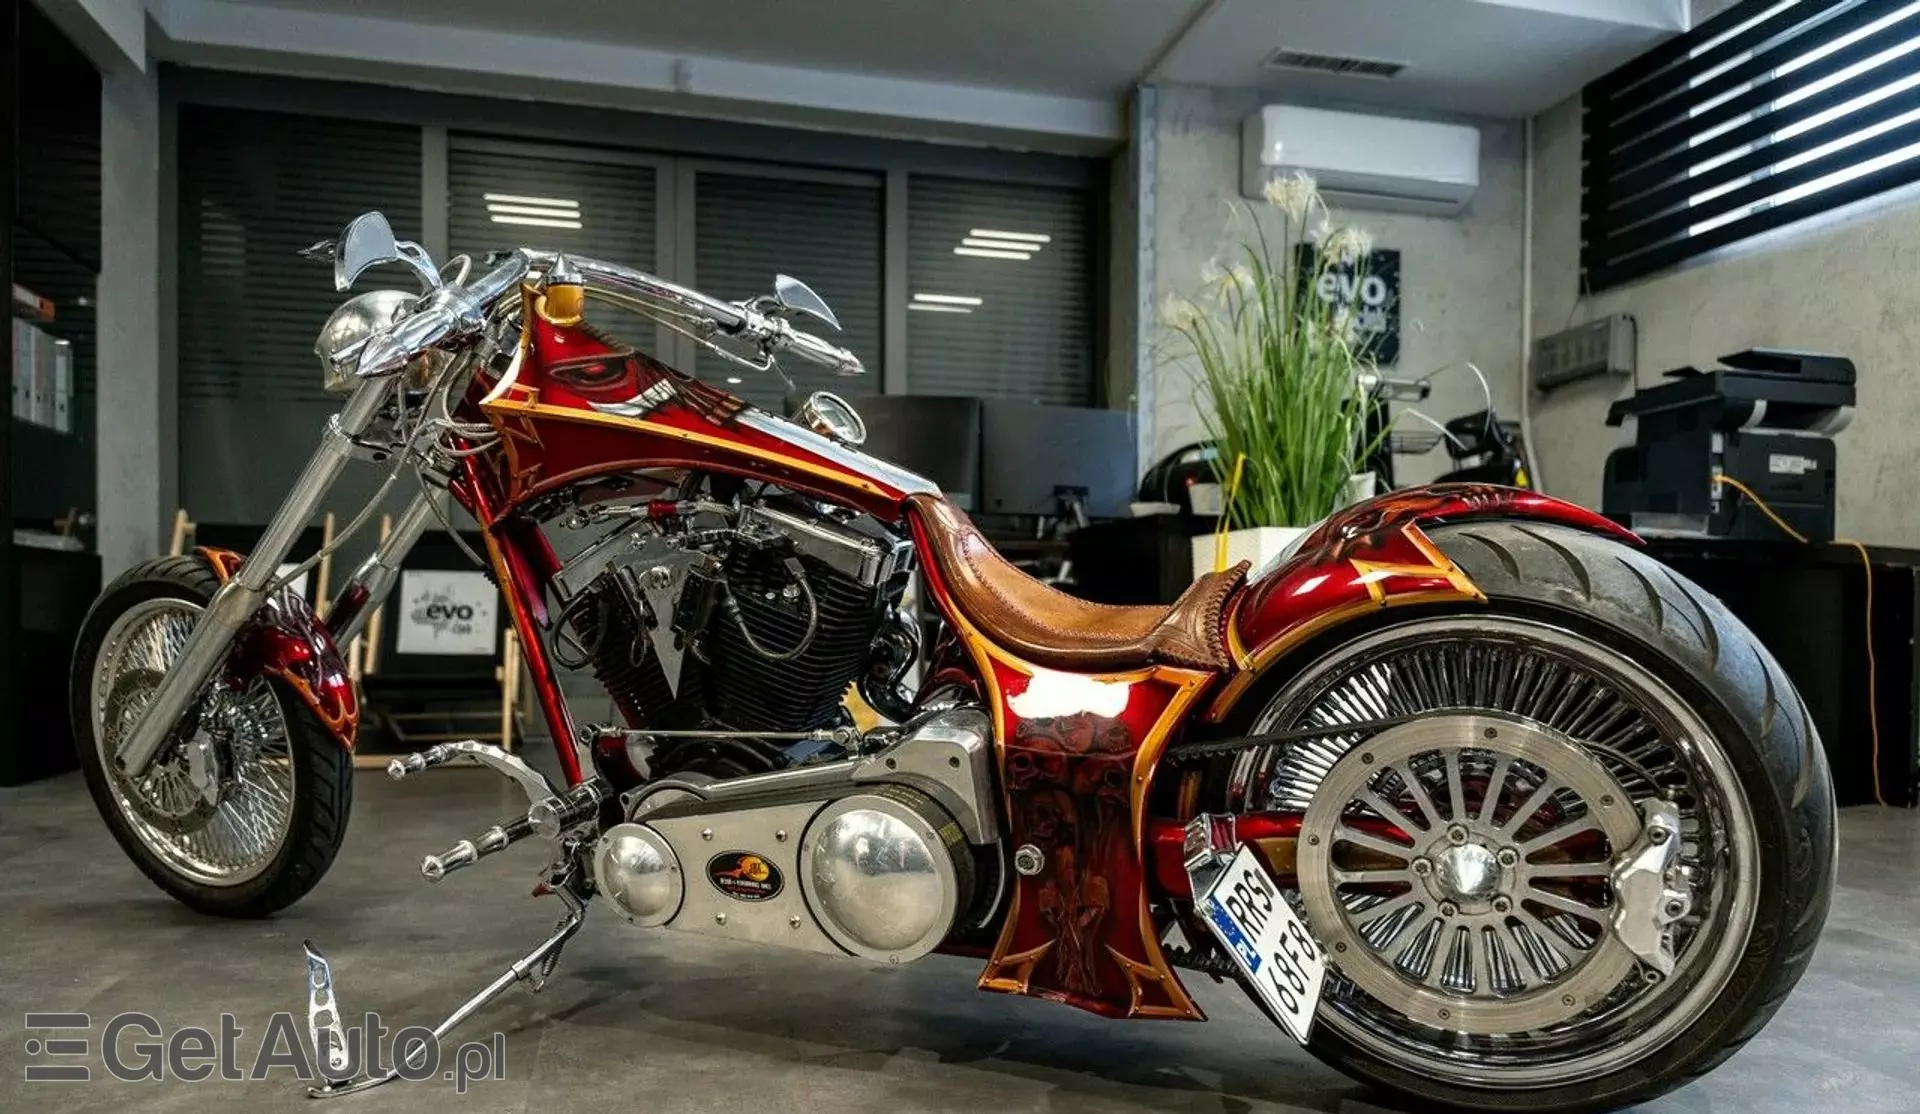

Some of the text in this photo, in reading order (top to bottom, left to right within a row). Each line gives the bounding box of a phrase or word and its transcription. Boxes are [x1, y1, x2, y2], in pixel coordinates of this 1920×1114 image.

[1316, 272, 1387, 305] evo
[426, 604, 474, 620] evo
[1225, 869, 1273, 944] RRS
[1268, 919, 1316, 1015] 68F8
